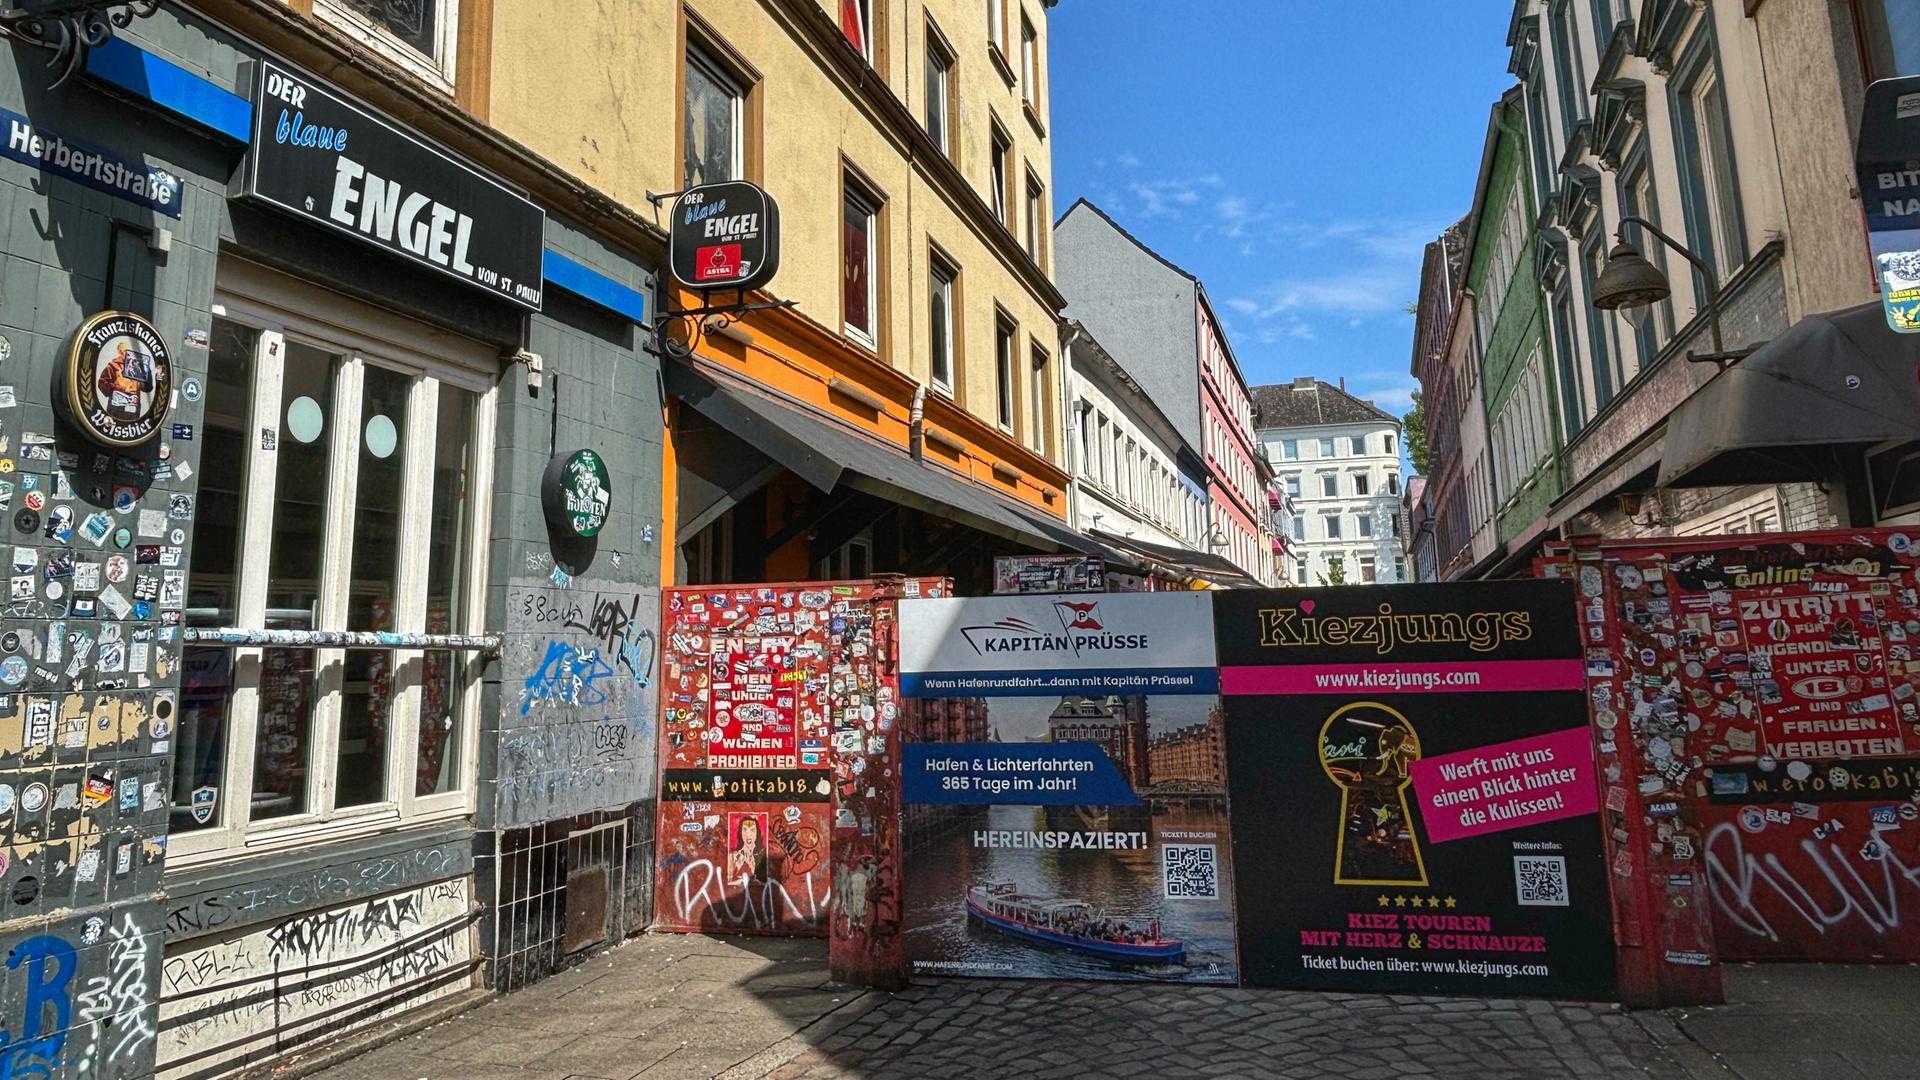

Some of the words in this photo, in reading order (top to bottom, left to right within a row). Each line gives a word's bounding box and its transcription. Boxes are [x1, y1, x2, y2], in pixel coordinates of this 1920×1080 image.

[267, 73, 307, 109] DER
[276, 109, 348, 151] blaue
[9, 120, 171, 205] Herbertstraße
[684, 193, 704, 205] DER
[330, 155, 474, 276] ENGEL
[684, 198, 727, 226] blaue
[704, 213, 759, 238] ENGEL
[705, 267, 731, 275] ASTRA
[477, 266, 497, 287] VON
[516, 284, 541, 304] PAULI
[87, 320, 165, 358] Franziskaner
[566, 494, 606, 517] HOLTEN
[1741, 592, 1872, 620] ZUTRITT
[1258, 602, 1532, 654] Kiezjungs
[985, 633, 1068, 652] KAPITÄN
[1076, 631, 1148, 650] PRÜSSE
[1785, 659, 1850, 675] UNTER
[734, 674, 772, 685] MEN
[925, 679, 957, 688] Wenn
[1082, 676, 1101, 686] mit
[1103, 675, 1149, 687] Kapitän
[1315, 669, 1481, 690] www.kiezjungs.com
[1809, 701, 1842, 712] UND
[742, 723, 763, 732] AND
[1783, 717, 1877, 734] FRAUEN
[1767, 737, 1905, 760] VERBOTEN
[709, 755, 796, 768] PROHIBITED
[925, 757, 969, 772] Hafen
[972, 759, 984, 771] &
[987, 756, 1094, 773] Lichterfahrten
[1440, 757, 1490, 782] Werft
[1491, 751, 1522, 773] mit
[1524, 747, 1554, 765] uns
[942, 777, 970, 790] 365
[972, 776, 1010, 794] Tage
[1013, 776, 1035, 790] im
[1037, 776, 1077, 791] Jahr!
[1432, 787, 1480, 808] einen
[1481, 775, 1524, 799] Blick
[1524, 767, 1577, 789] hinter
[1460, 808, 1487, 827] die
[1488, 791, 1565, 821] Kulissen!
[973, 831, 1149, 850] HEREINSPAZIERT!
[1512, 841, 1541, 850] Weitere
[1347, 913, 1400, 929] KIEZ
[1403, 914, 1491, 931] TOUREN
[1300, 930, 1341, 946] MIT
[1346, 932, 1402, 948] HERZ
[1407, 933, 1422, 949] &
[1427, 934, 1547, 953] SCHNAUZE
[1302, 954, 1338, 970] Ticket
[1339, 956, 1384, 972] buchen
[1387, 956, 1419, 972] über:
[1422, 959, 1549, 978] www.kiezjungs.com
